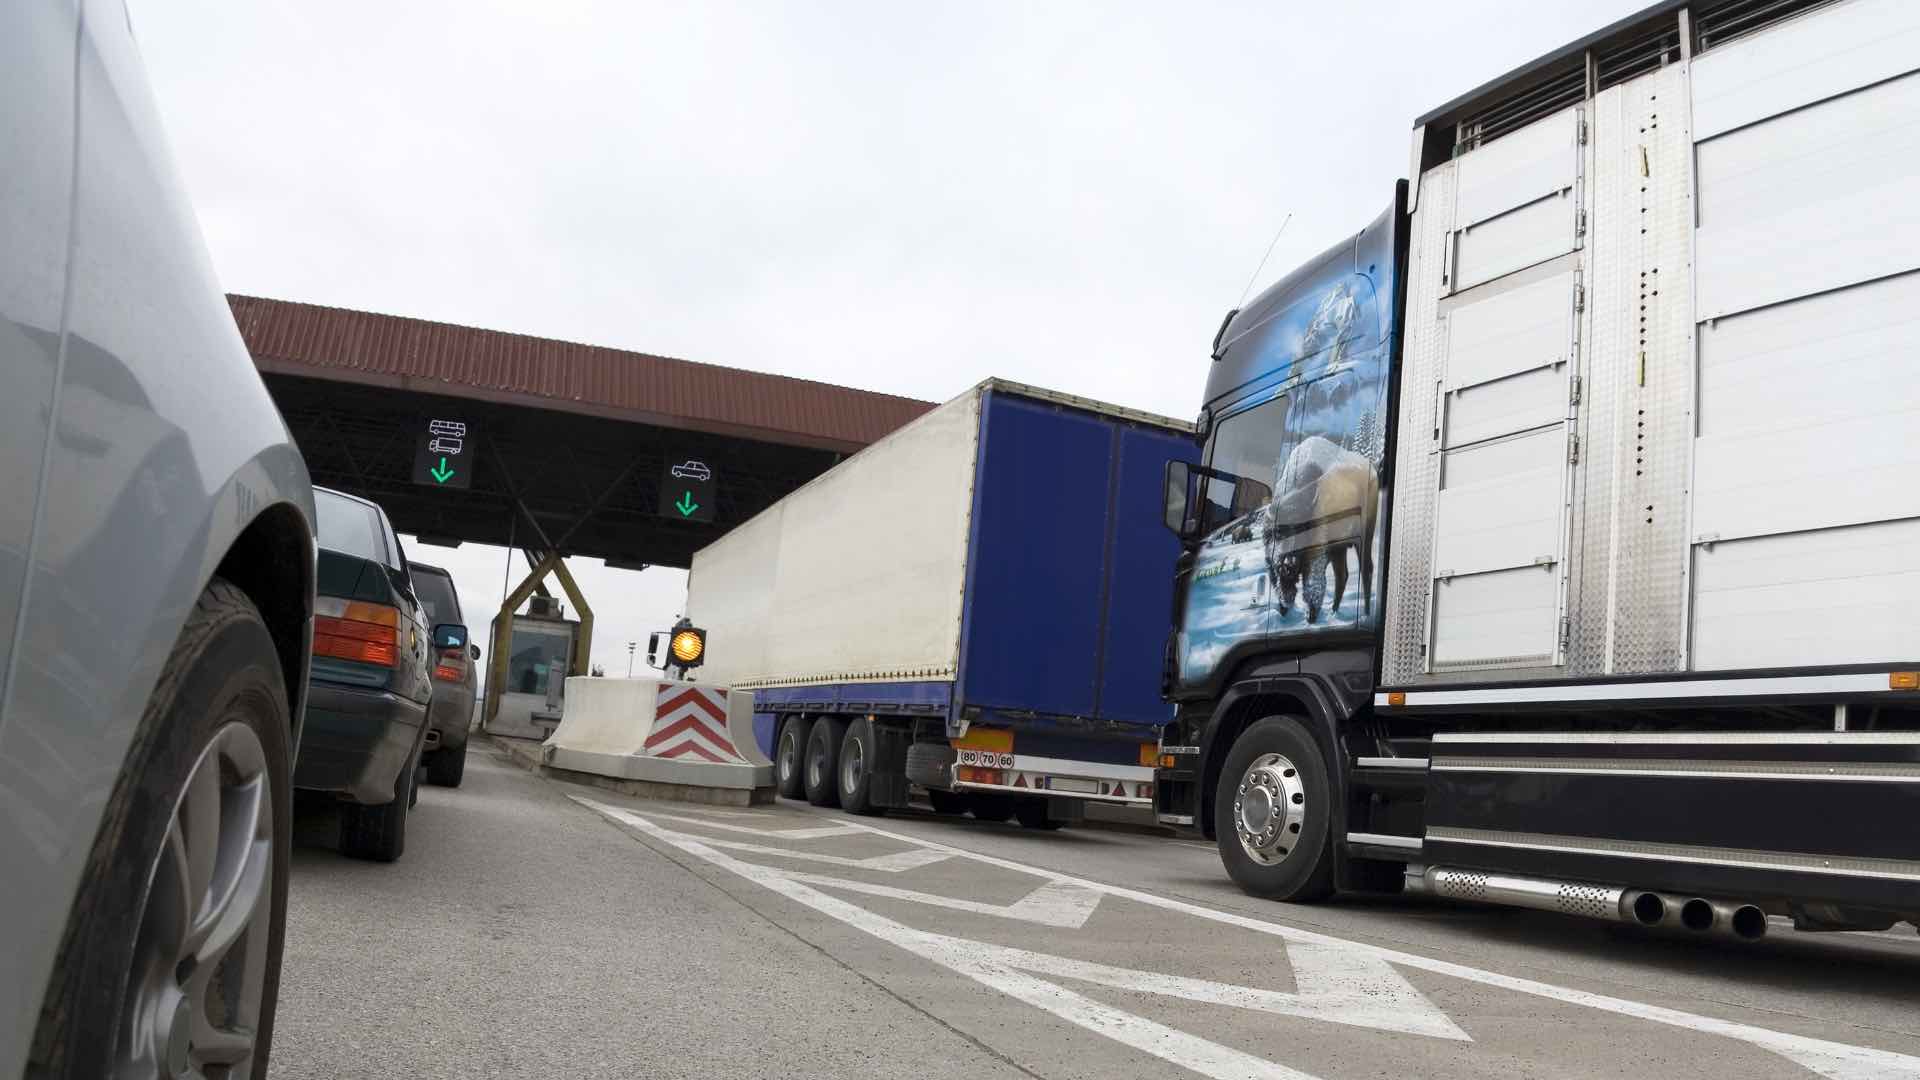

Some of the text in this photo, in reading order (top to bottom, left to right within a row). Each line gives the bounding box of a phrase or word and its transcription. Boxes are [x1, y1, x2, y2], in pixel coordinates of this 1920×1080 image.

[963, 752, 976, 762] 80
[982, 754, 994, 764] 70
[1000, 756, 1012, 767] 60
